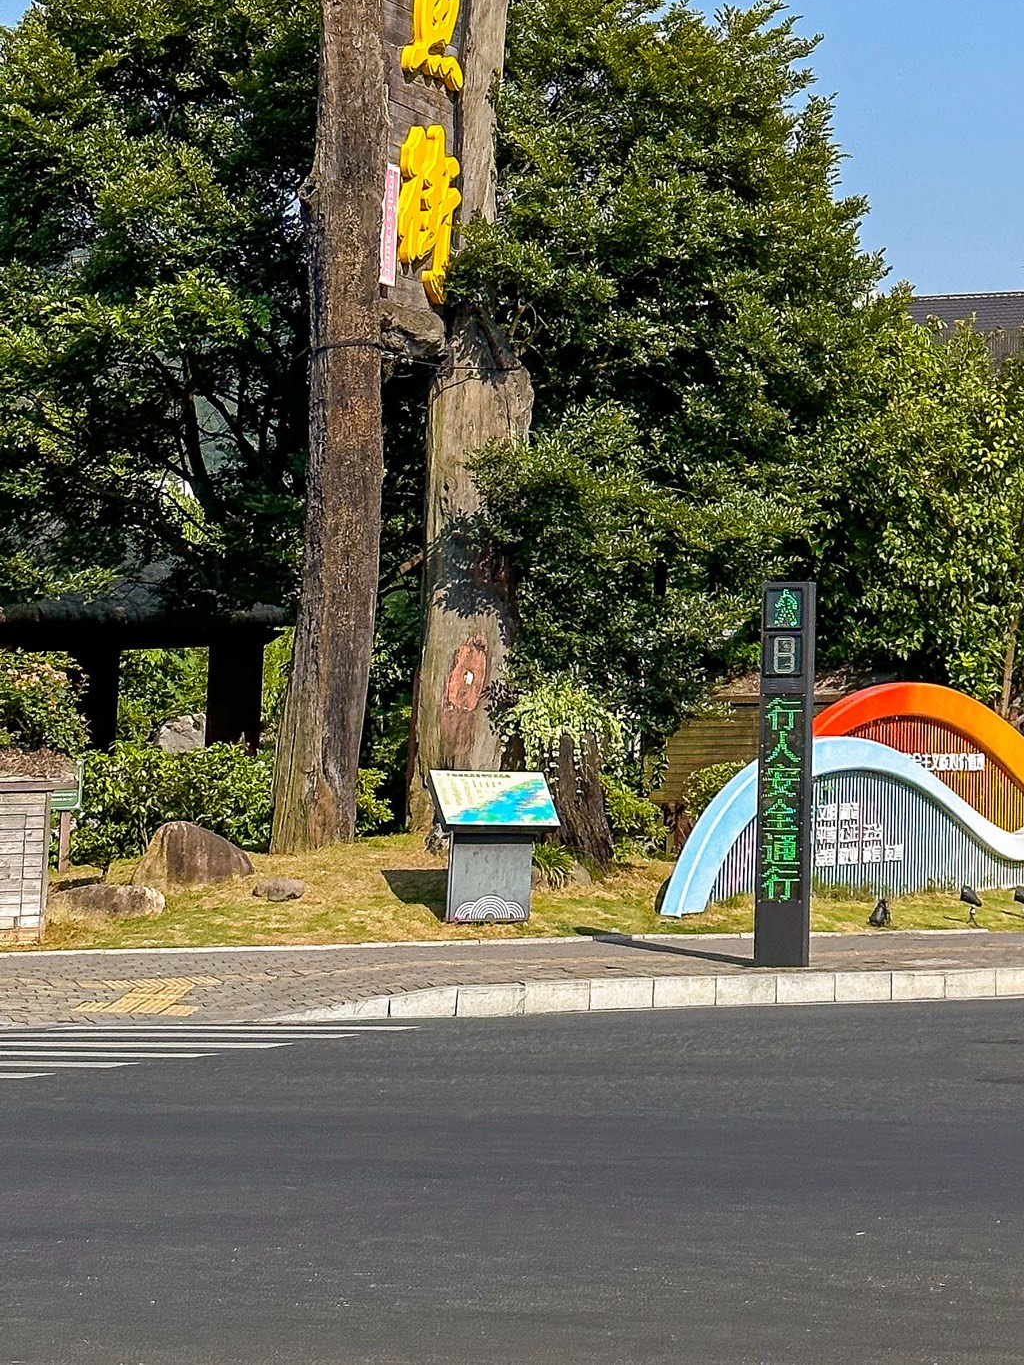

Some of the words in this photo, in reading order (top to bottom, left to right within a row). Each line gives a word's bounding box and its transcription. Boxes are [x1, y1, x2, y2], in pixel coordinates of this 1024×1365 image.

[763, 698, 803, 901] 行人安全通行
